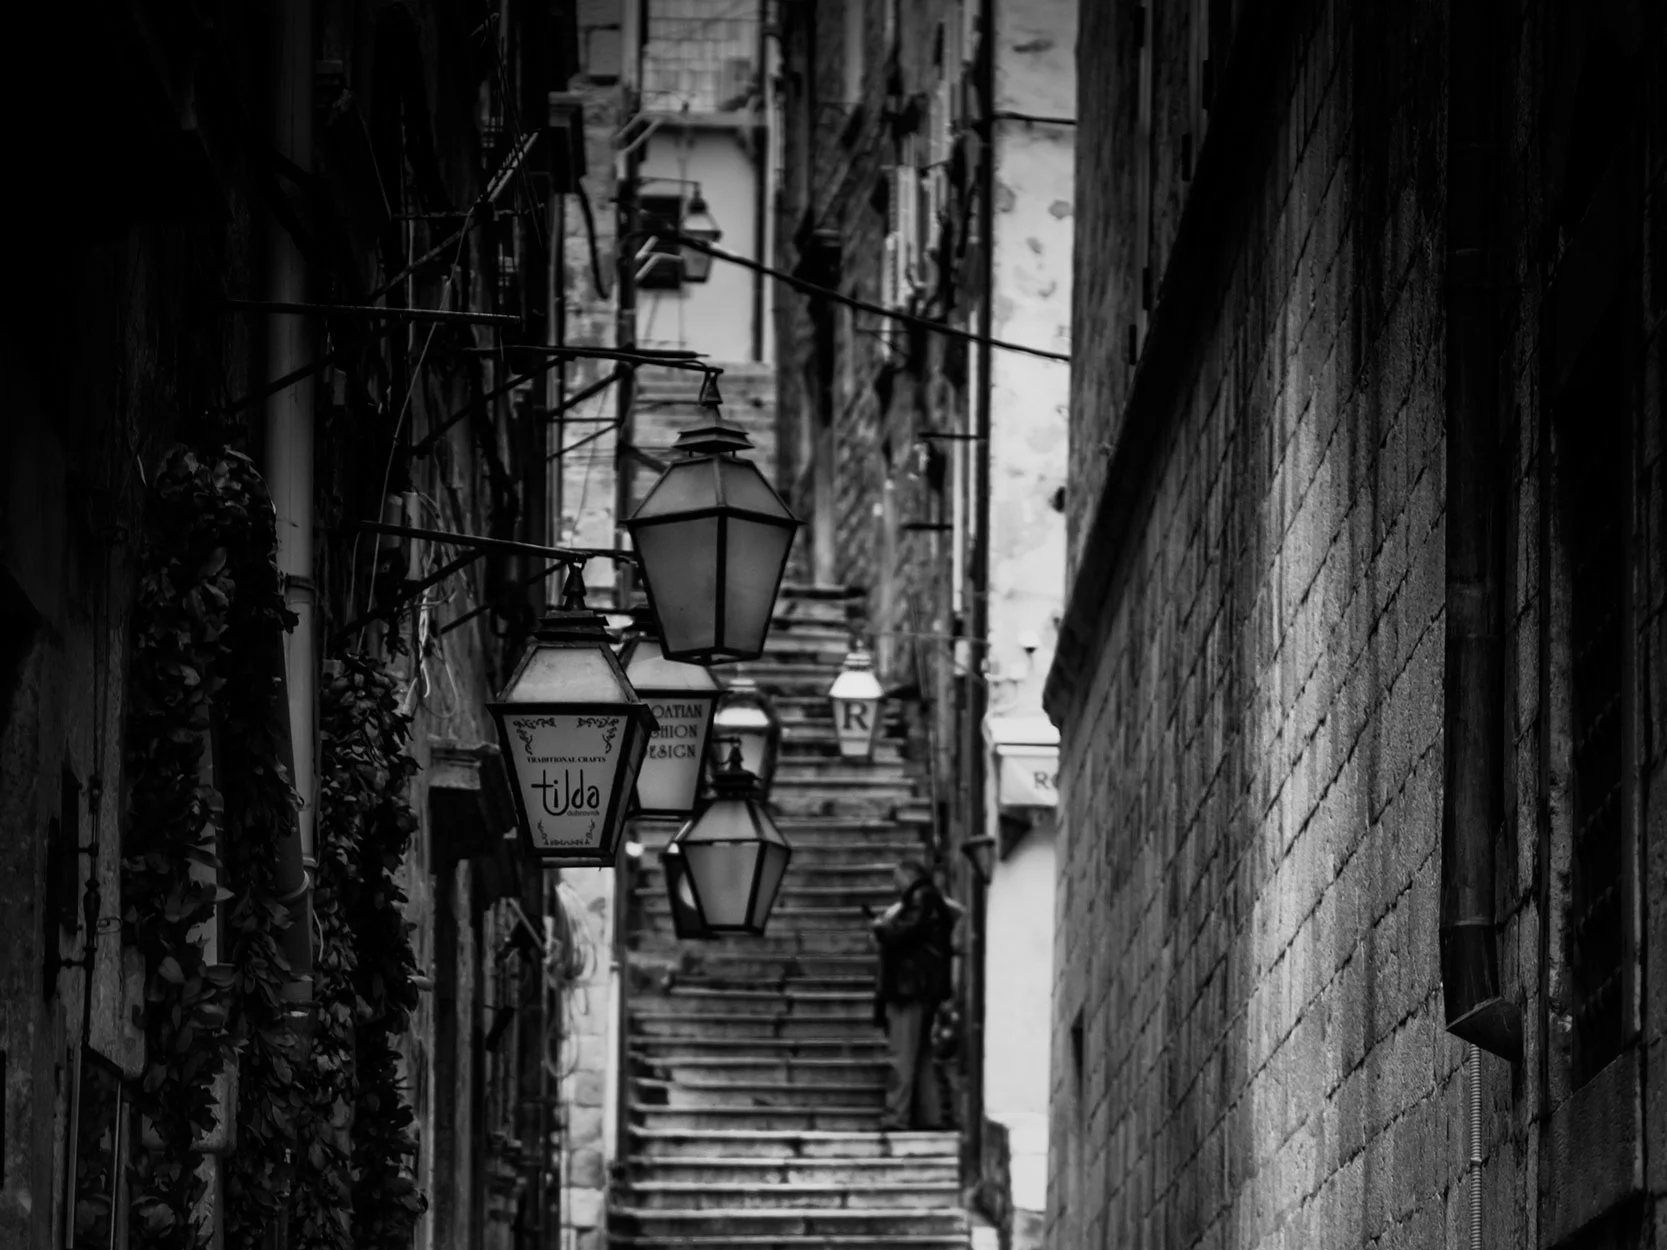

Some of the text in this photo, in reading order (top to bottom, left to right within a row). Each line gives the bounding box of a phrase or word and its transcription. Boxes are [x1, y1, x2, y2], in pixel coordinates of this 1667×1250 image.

[651, 704, 703, 718] OATIAN
[843, 701, 869, 730] R
[649, 744, 696, 759] ESIGN
[531, 769, 600, 816] tilda
